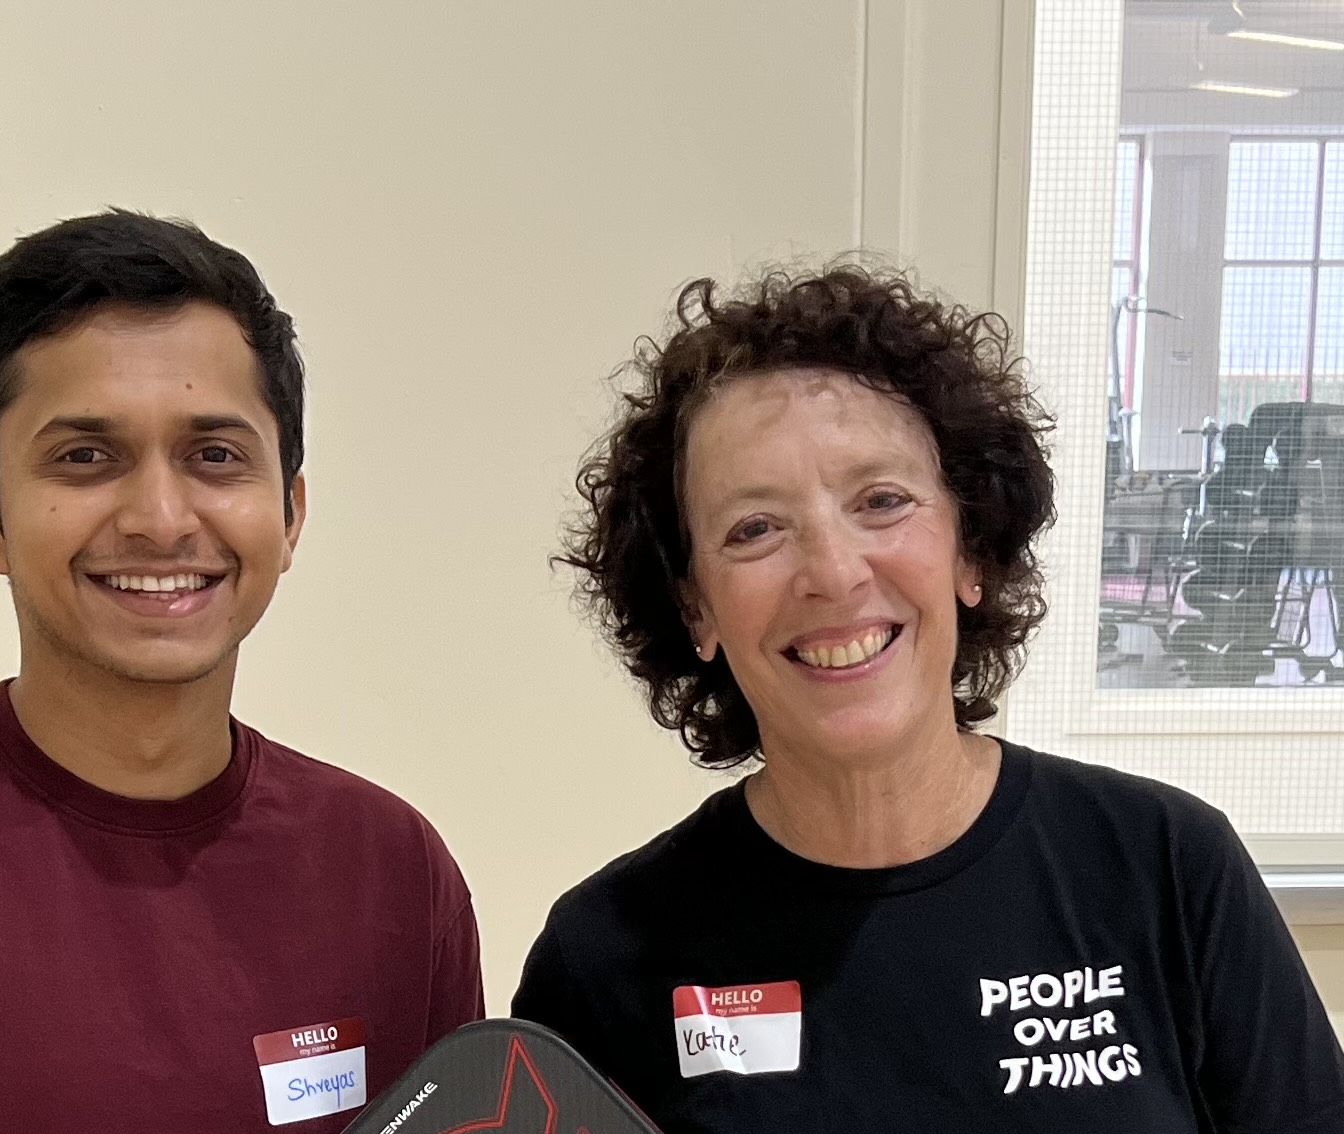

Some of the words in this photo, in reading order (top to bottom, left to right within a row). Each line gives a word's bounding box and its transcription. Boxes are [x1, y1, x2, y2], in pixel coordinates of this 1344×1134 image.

[712, 989, 762, 1005] HELLO
[980, 965, 1124, 1016] PEOPLE
[291, 1027, 337, 1047] HELLO
[1014, 1010, 1116, 1045] OVER
[300, 1048, 310, 1056] my
[999, 1044, 1141, 1094] THINGS
[288, 1071, 354, 1108] Shreyas
